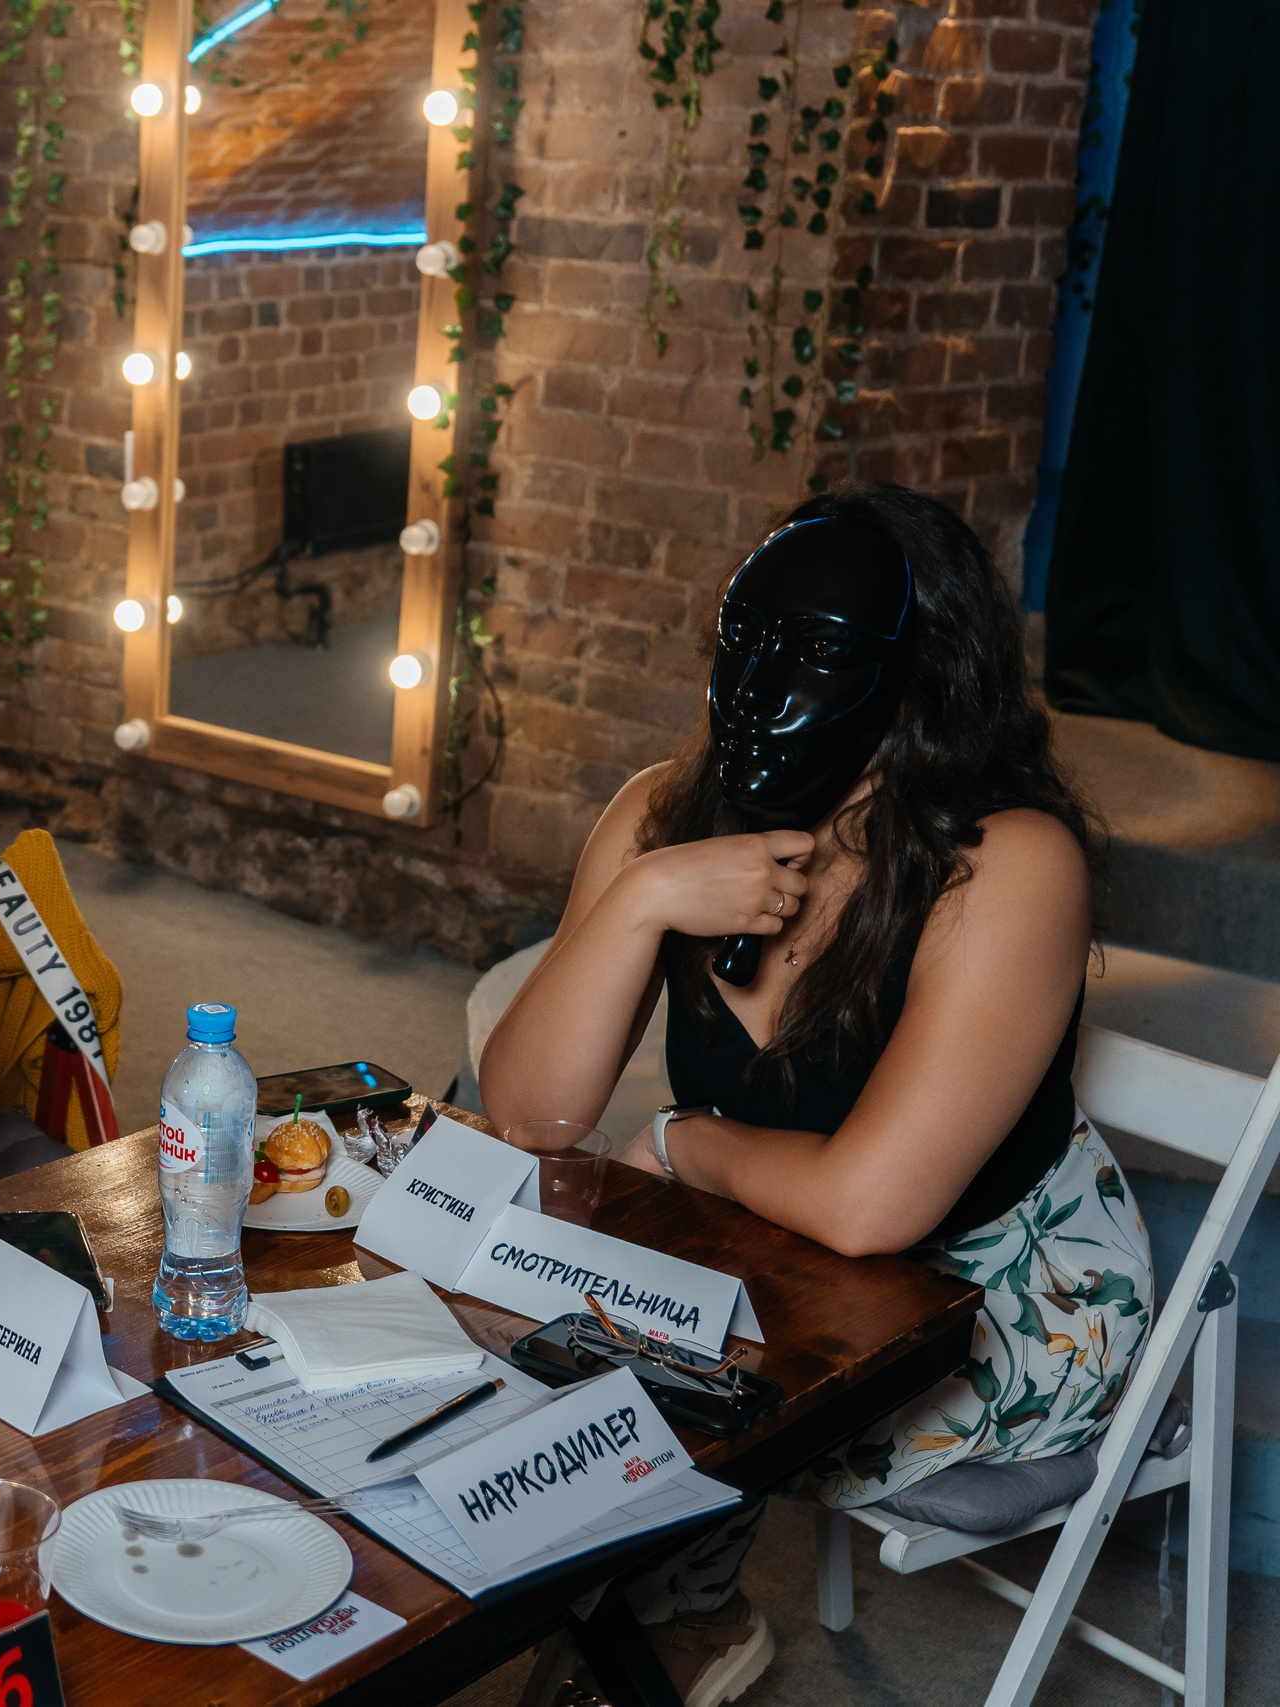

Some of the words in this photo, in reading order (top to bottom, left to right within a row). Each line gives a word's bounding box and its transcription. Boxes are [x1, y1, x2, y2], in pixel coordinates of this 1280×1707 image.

[160, 1120, 185, 1145] той
[406, 1178, 476, 1223] КРИСТИНА
[490, 1242, 701, 1334] СМОТРИТЕЛЬНИЦА
[648, 1329, 670, 1341] MAFIA
[458, 1406, 640, 1523] НАРКОДИЛЕР
[623, 1455, 642, 1470] MAFIA
